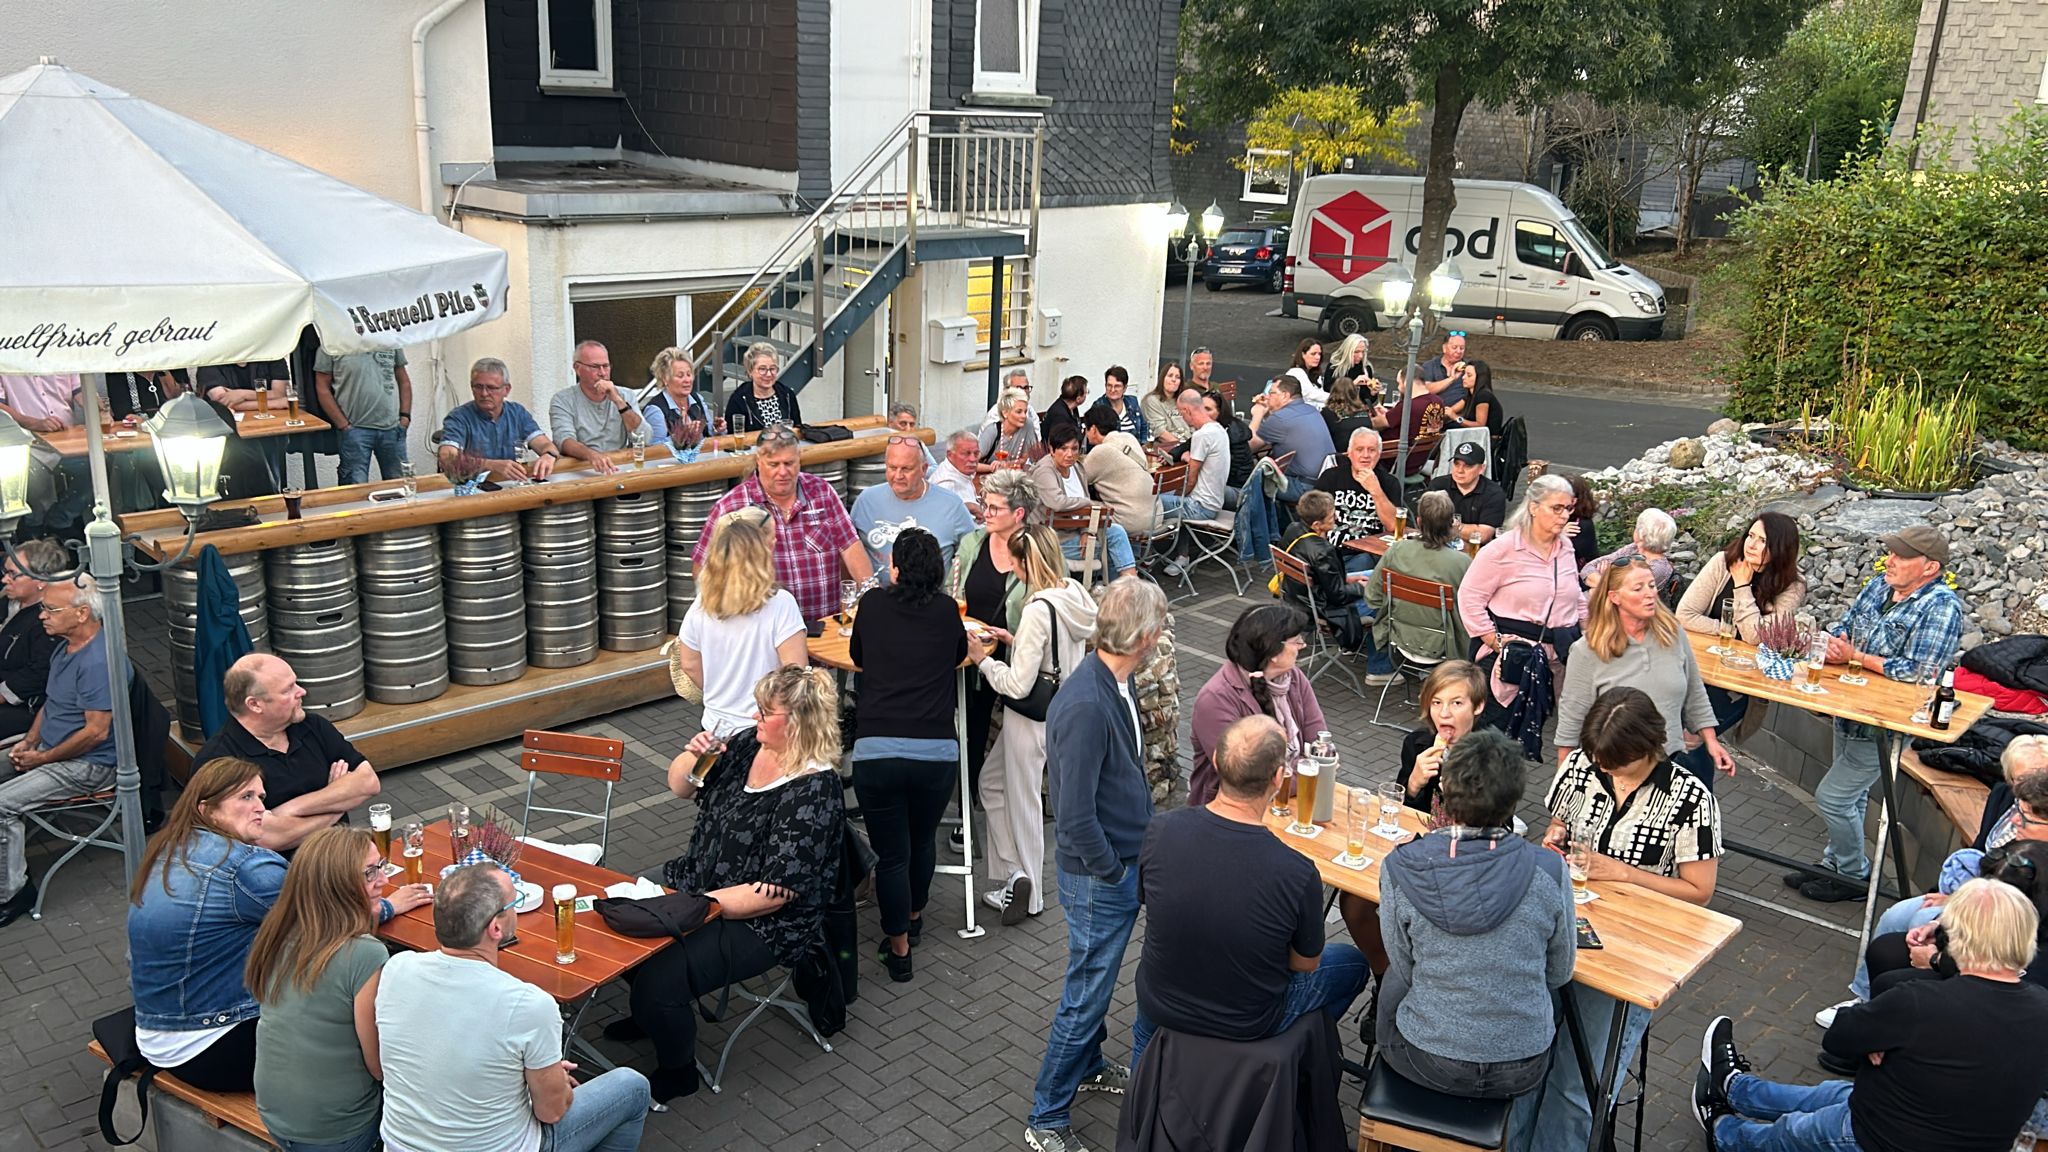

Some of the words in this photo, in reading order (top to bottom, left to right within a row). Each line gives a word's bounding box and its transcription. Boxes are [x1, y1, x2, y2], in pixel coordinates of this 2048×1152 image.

[356, 293, 434, 333] Erzquell
[434, 290, 476, 318] Pils
[0, 322, 117, 357] uellfrisch
[115, 316, 218, 357] gebraut
[1334, 490, 1375, 509] BÖSE
